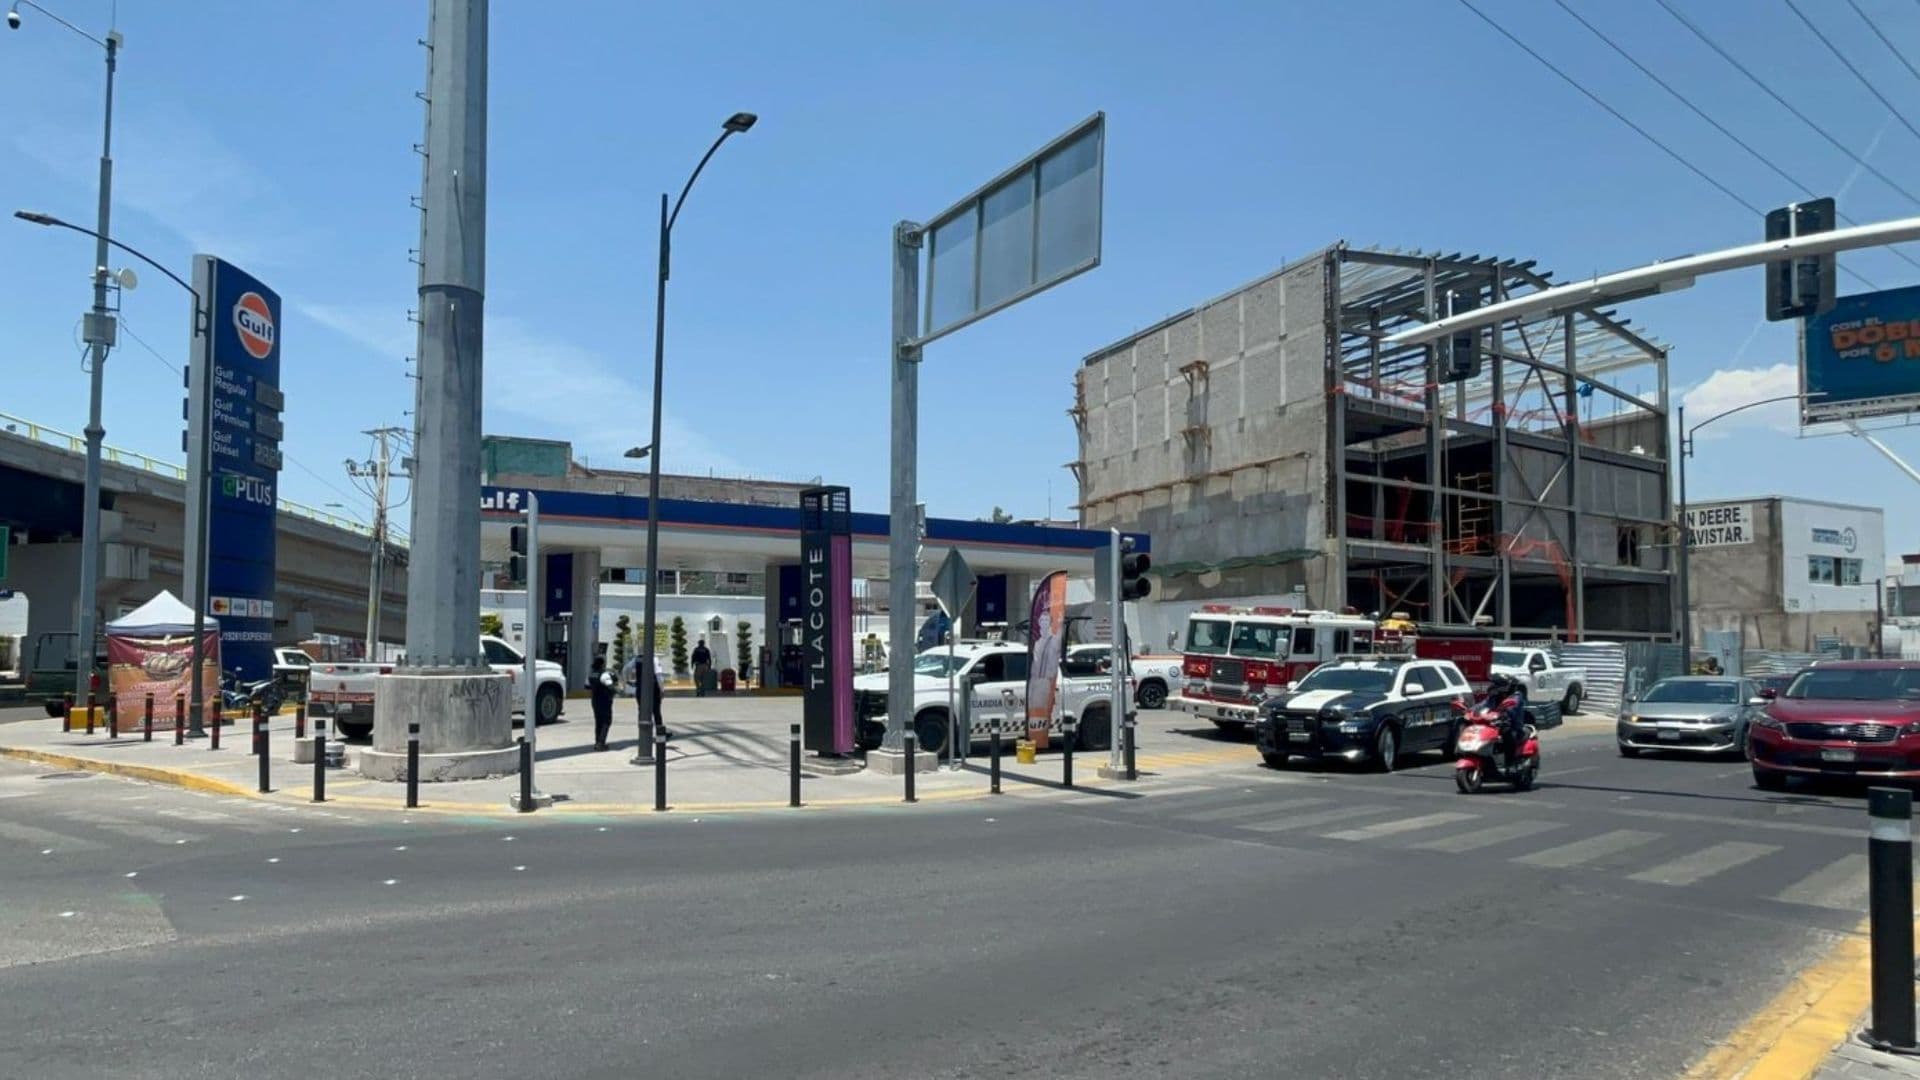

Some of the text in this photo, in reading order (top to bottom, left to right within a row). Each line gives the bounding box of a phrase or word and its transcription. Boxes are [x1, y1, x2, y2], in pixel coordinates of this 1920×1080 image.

[238, 309, 273, 341] Gulf
[1829, 316, 1883, 332] CON EL
[1839, 347, 1871, 359] POR
[215, 366, 234, 381] Gulf
[214, 376, 247, 397] Regular
[214, 398, 233, 412] Gulf
[214, 409, 250, 430] Premium
[213, 430, 232, 444] Gulf
[480, 491, 520, 510] ulf
[1699, 506, 1741, 526] DEERE
[1688, 526, 1743, 546] AVISTAR
[809, 548, 825, 690] TLACOTE
[970, 697, 1003, 709] UARDIA
